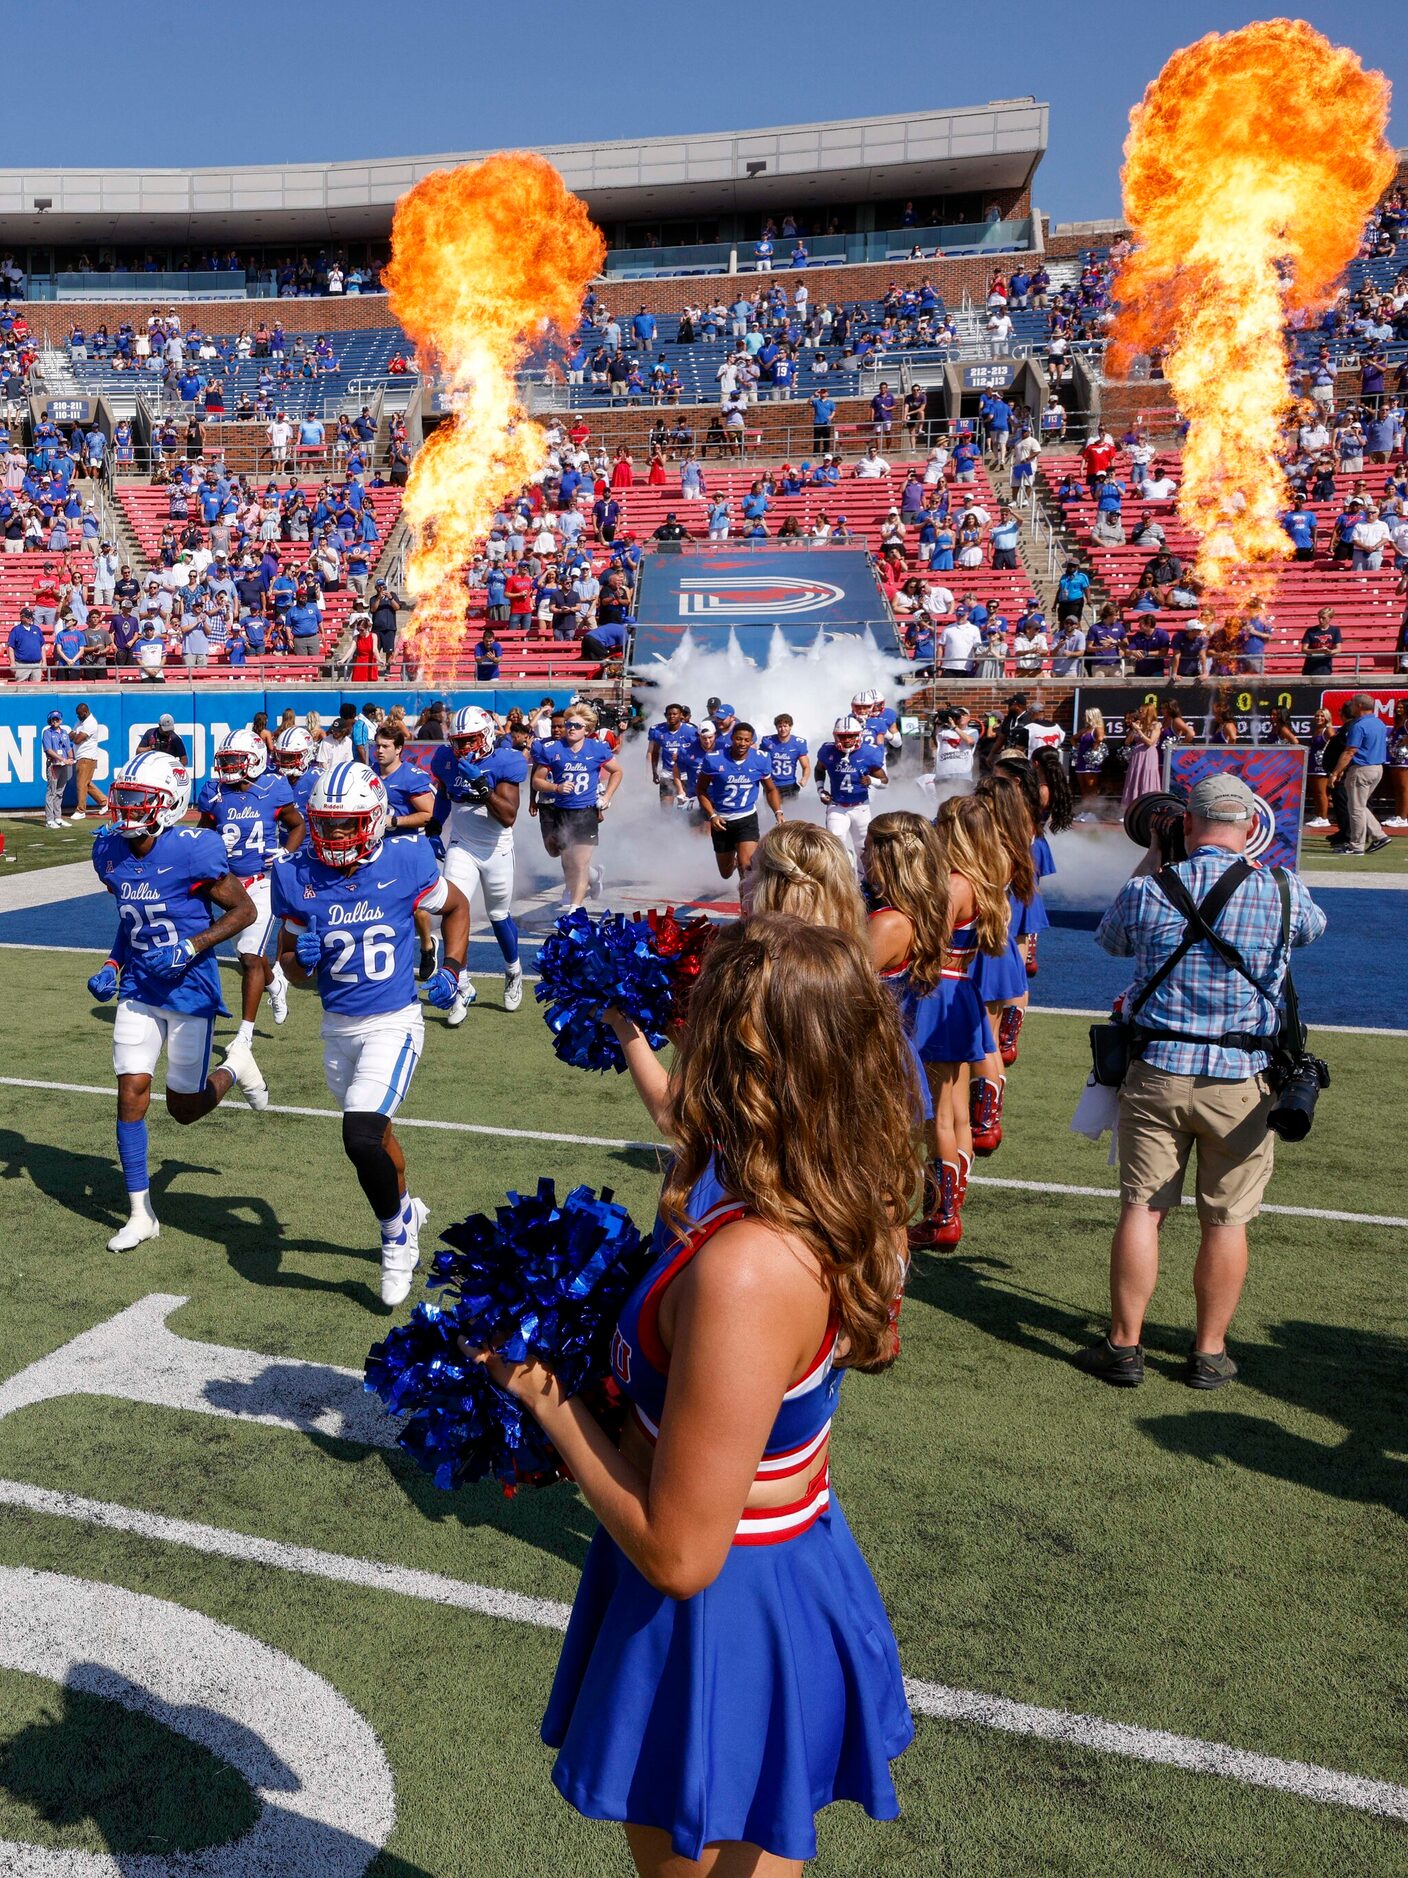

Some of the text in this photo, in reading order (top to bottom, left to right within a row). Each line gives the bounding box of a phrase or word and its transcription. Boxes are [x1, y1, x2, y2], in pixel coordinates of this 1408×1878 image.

[970, 366, 1008, 377] 212-213
[53, 401, 82, 411] 210-211
[55, 411, 81, 420] 110-111
[960, 420, 970, 428] 112
[121, 447, 130, 455] 111
[665, 740, 681, 748] Dallas
[774, 751, 791, 760] Dallas
[564, 763, 588, 772] Dallas
[771, 760, 793, 776] 35
[834, 763, 858, 773] Dallas
[726, 774, 751, 784] Dallas
[839, 773, 854, 793] 4
[722, 784, 753, 807] 27
[227, 807, 261, 821] Dallas
[221, 820, 266, 857] 24
[121, 882, 161, 900] Dallas
[328, 900, 385, 926] Dallas
[119, 903, 179, 951] 25
[323, 924, 397, 983] 26
